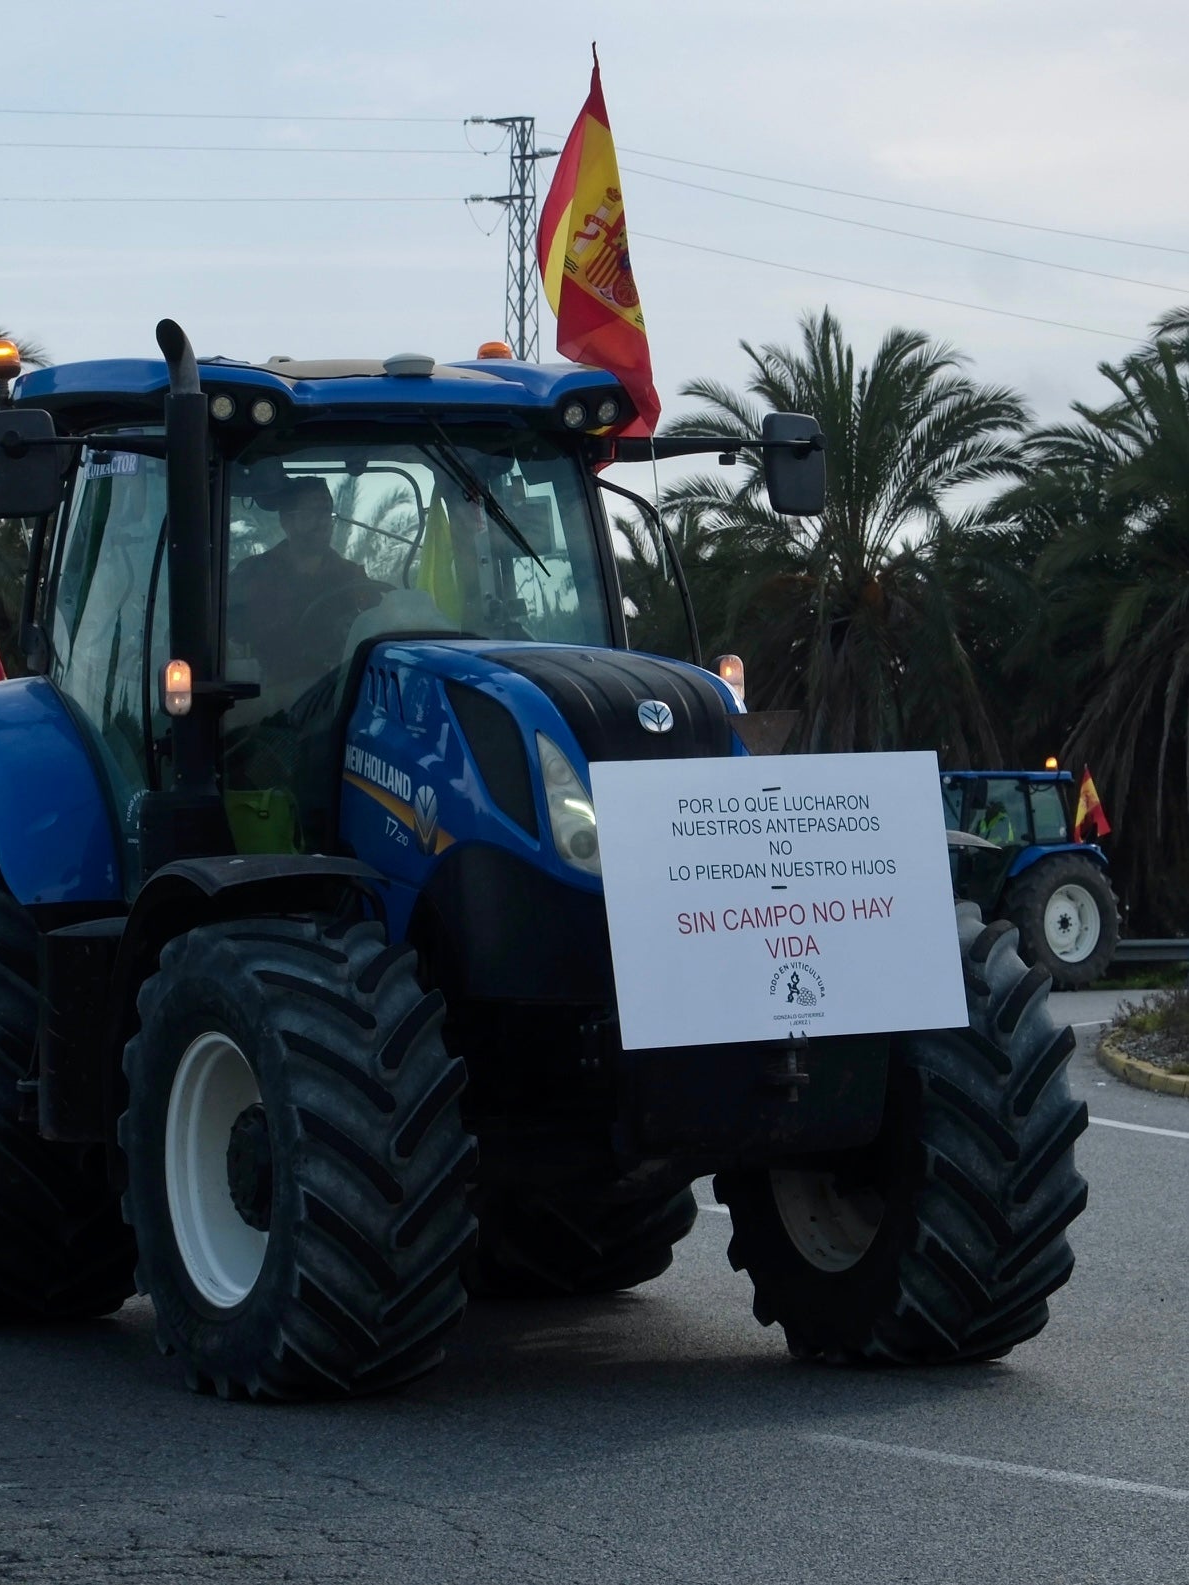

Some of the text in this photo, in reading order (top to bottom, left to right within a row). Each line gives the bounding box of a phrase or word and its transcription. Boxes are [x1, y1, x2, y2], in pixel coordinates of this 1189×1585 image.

[344, 744, 411, 801] NEW HOLLAND
[678, 794, 870, 815] POR LO QUE LUCHARON
[671, 816, 881, 837] NUESTROS ANTEPASADOS
[768, 840, 793, 856] NO
[668, 859, 897, 882] LO PIERDAN NUESTRO HIJOS
[677, 895, 894, 935] SIN CAMPO NO HAY
[764, 934, 821, 960] VIDA
[769, 961, 826, 998] TODO EN VITICULTURA
